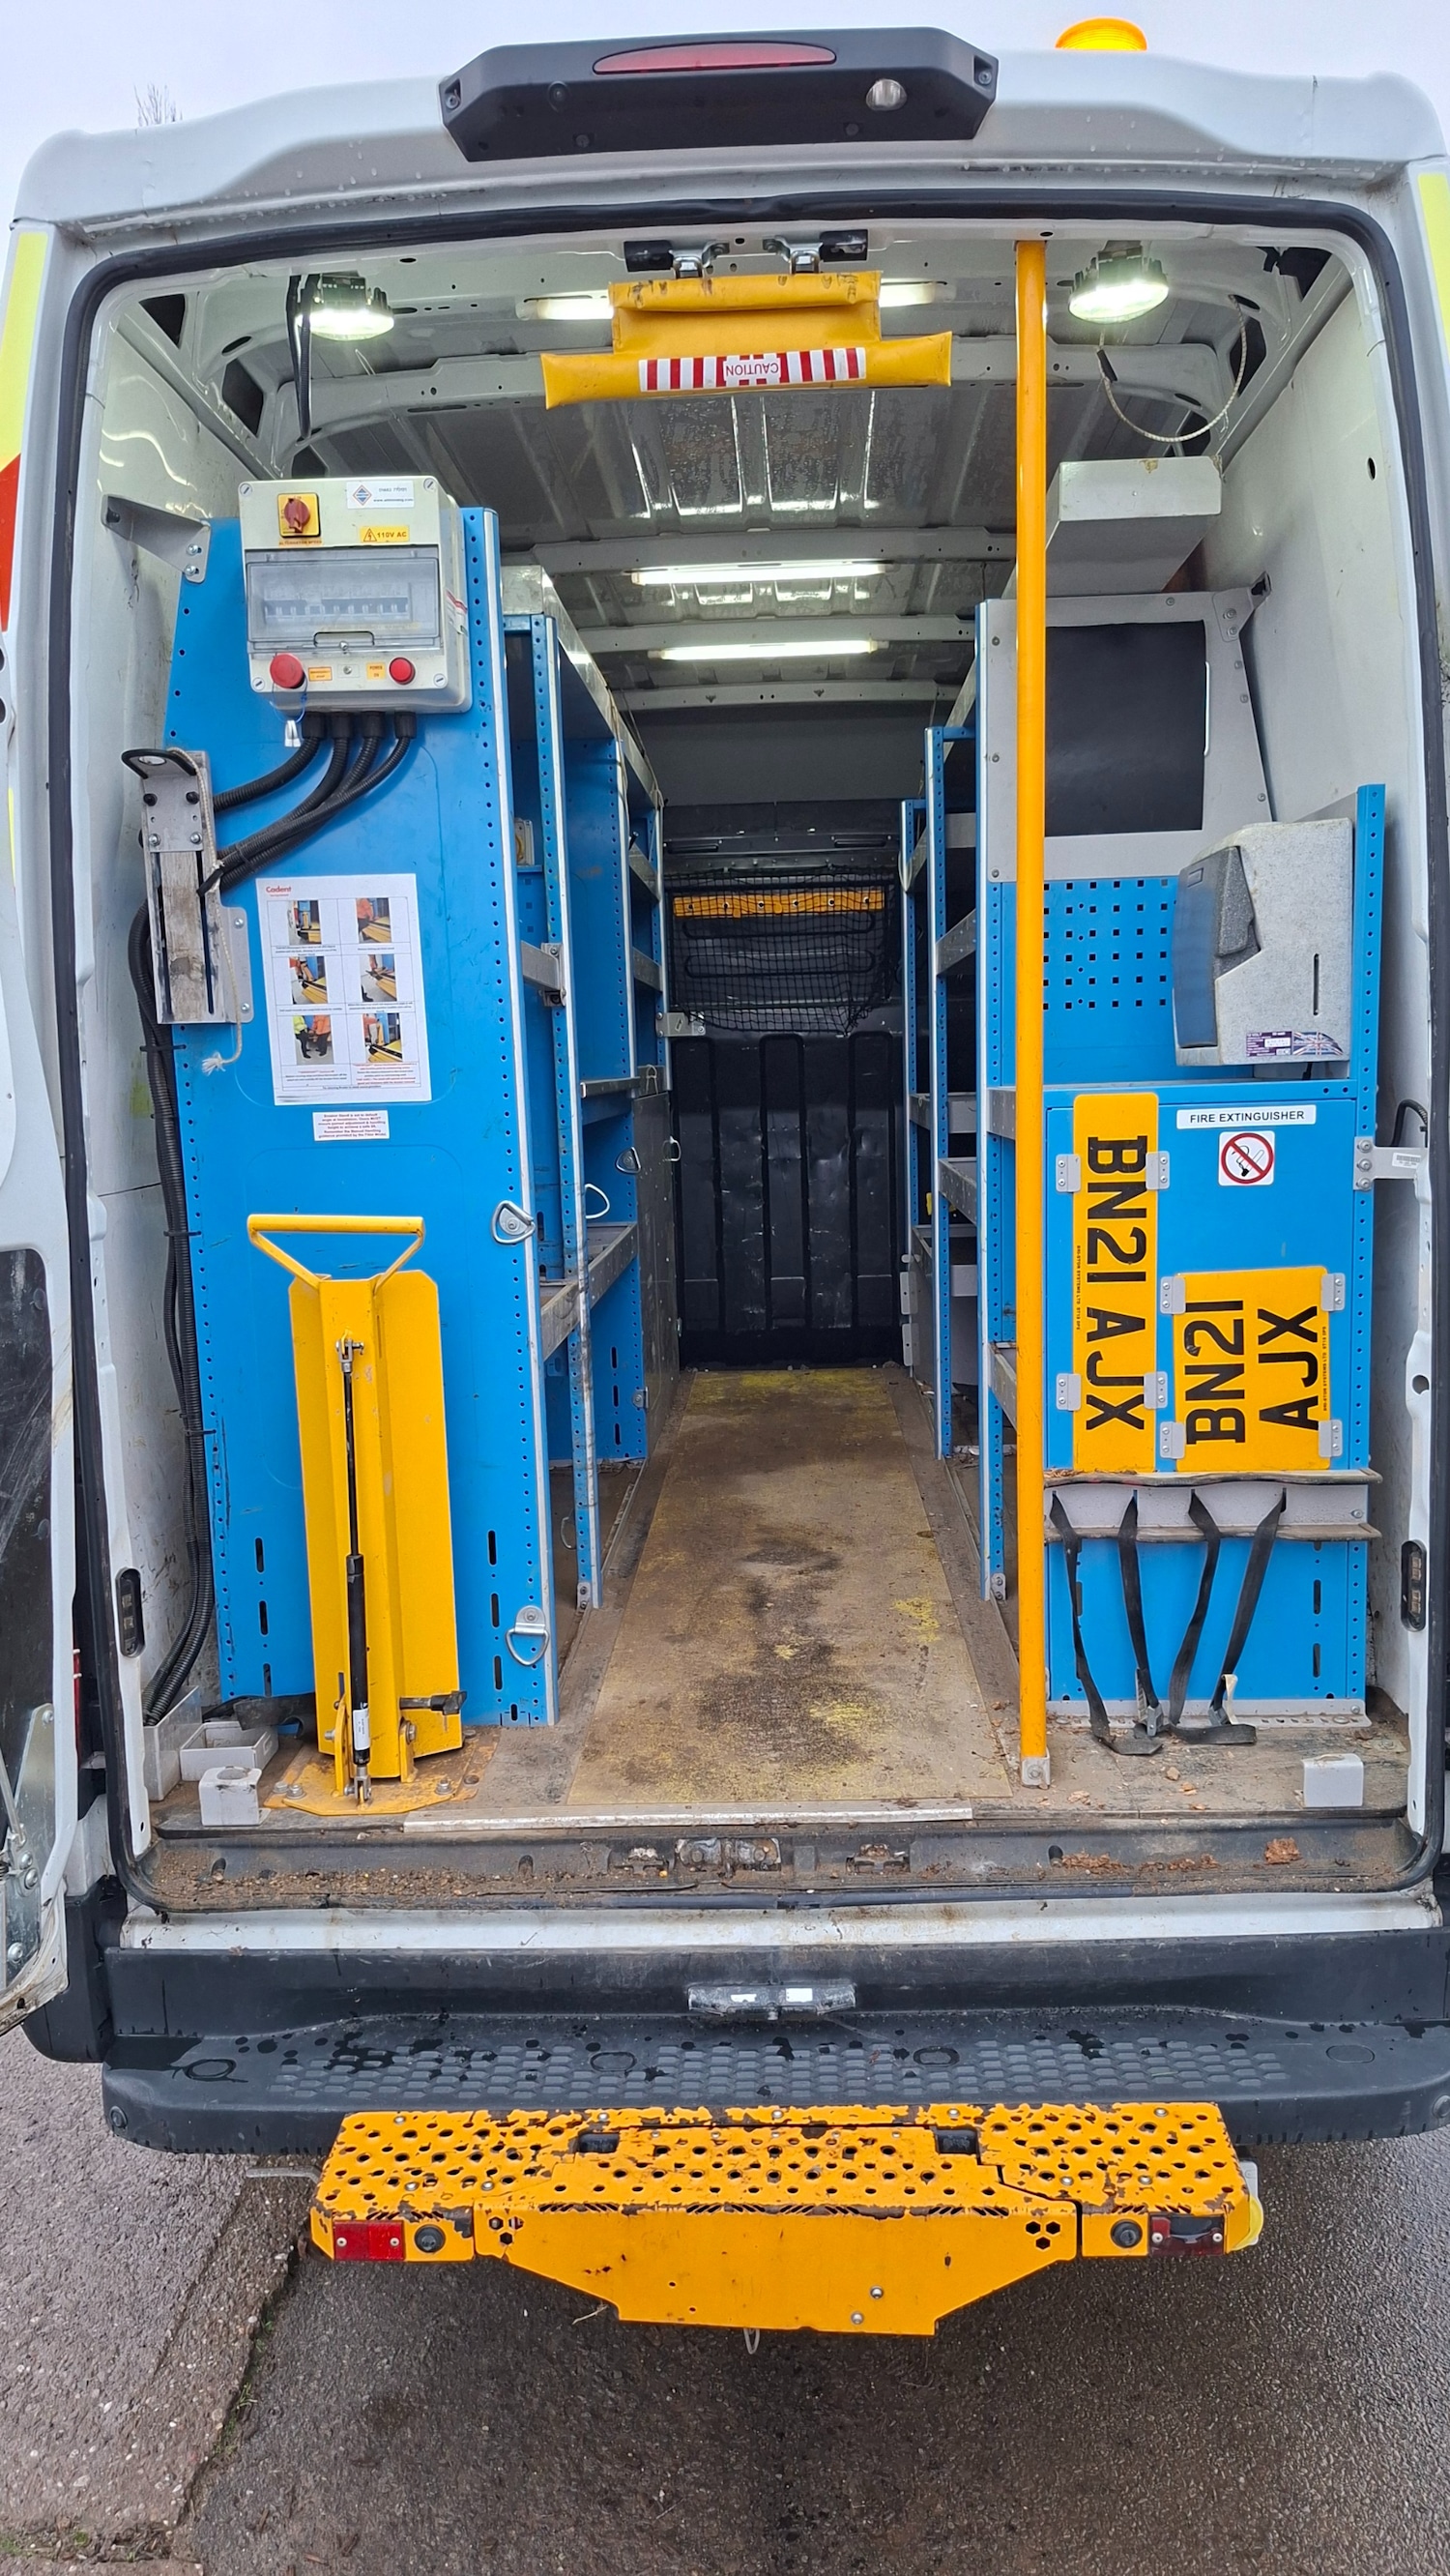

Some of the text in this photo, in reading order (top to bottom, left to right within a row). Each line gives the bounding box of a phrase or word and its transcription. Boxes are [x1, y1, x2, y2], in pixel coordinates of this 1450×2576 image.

[726, 363, 779, 377] CAUTION
[1190, 1110, 1305, 1124] FIRE EXTINGUISHER
[1086, 1306, 1146, 1430] AJX
[1257, 1305, 1319, 1430] AJX
